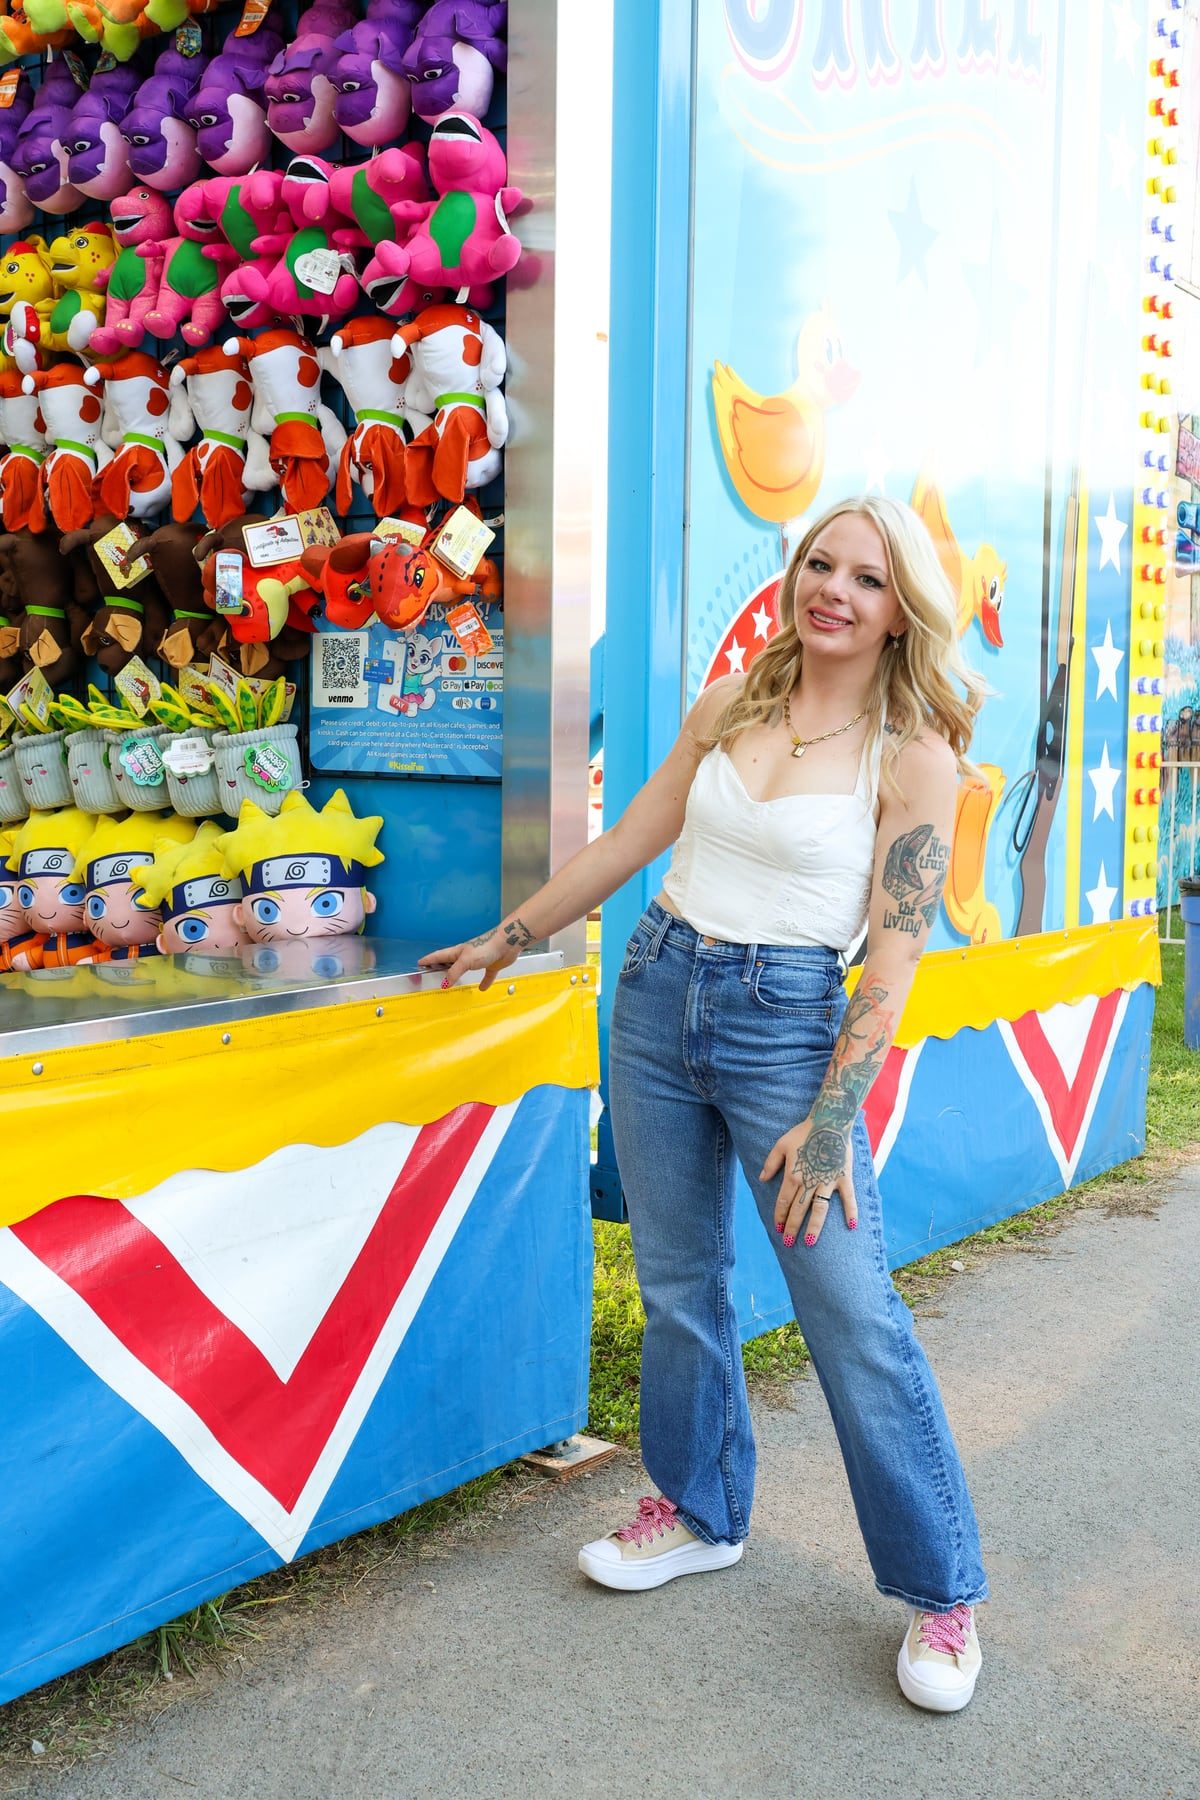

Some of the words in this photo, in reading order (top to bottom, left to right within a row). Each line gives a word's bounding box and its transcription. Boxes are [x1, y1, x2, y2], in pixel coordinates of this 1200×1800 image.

[443, 635, 461, 648] VI
[471, 681, 484, 691] Pay
[328, 695, 354, 703] venmo
[927, 836, 951, 859] Nev
[898, 901, 916, 916] the
